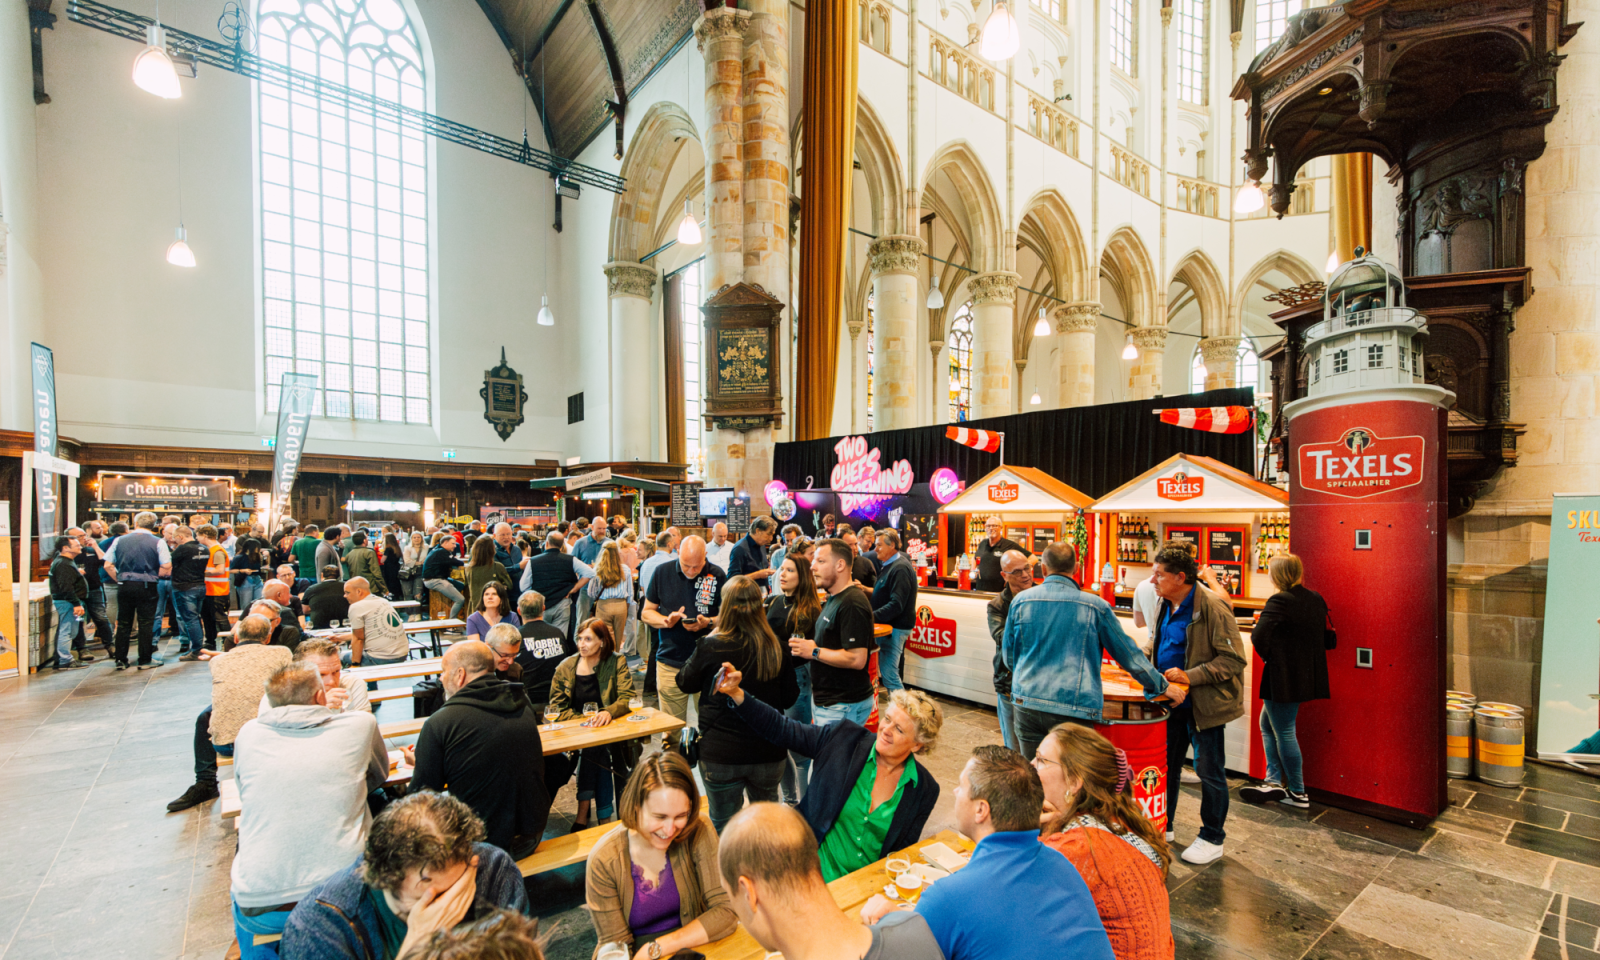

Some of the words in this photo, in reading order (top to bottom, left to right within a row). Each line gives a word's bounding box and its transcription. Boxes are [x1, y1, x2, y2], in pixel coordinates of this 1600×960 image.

[834, 436, 867, 463] TWO
[831, 447, 879, 491] CHEFS
[840, 459, 914, 512] BREWING
[525, 637, 560, 652] WOBBLY
[909, 625, 952, 648] EXELS
